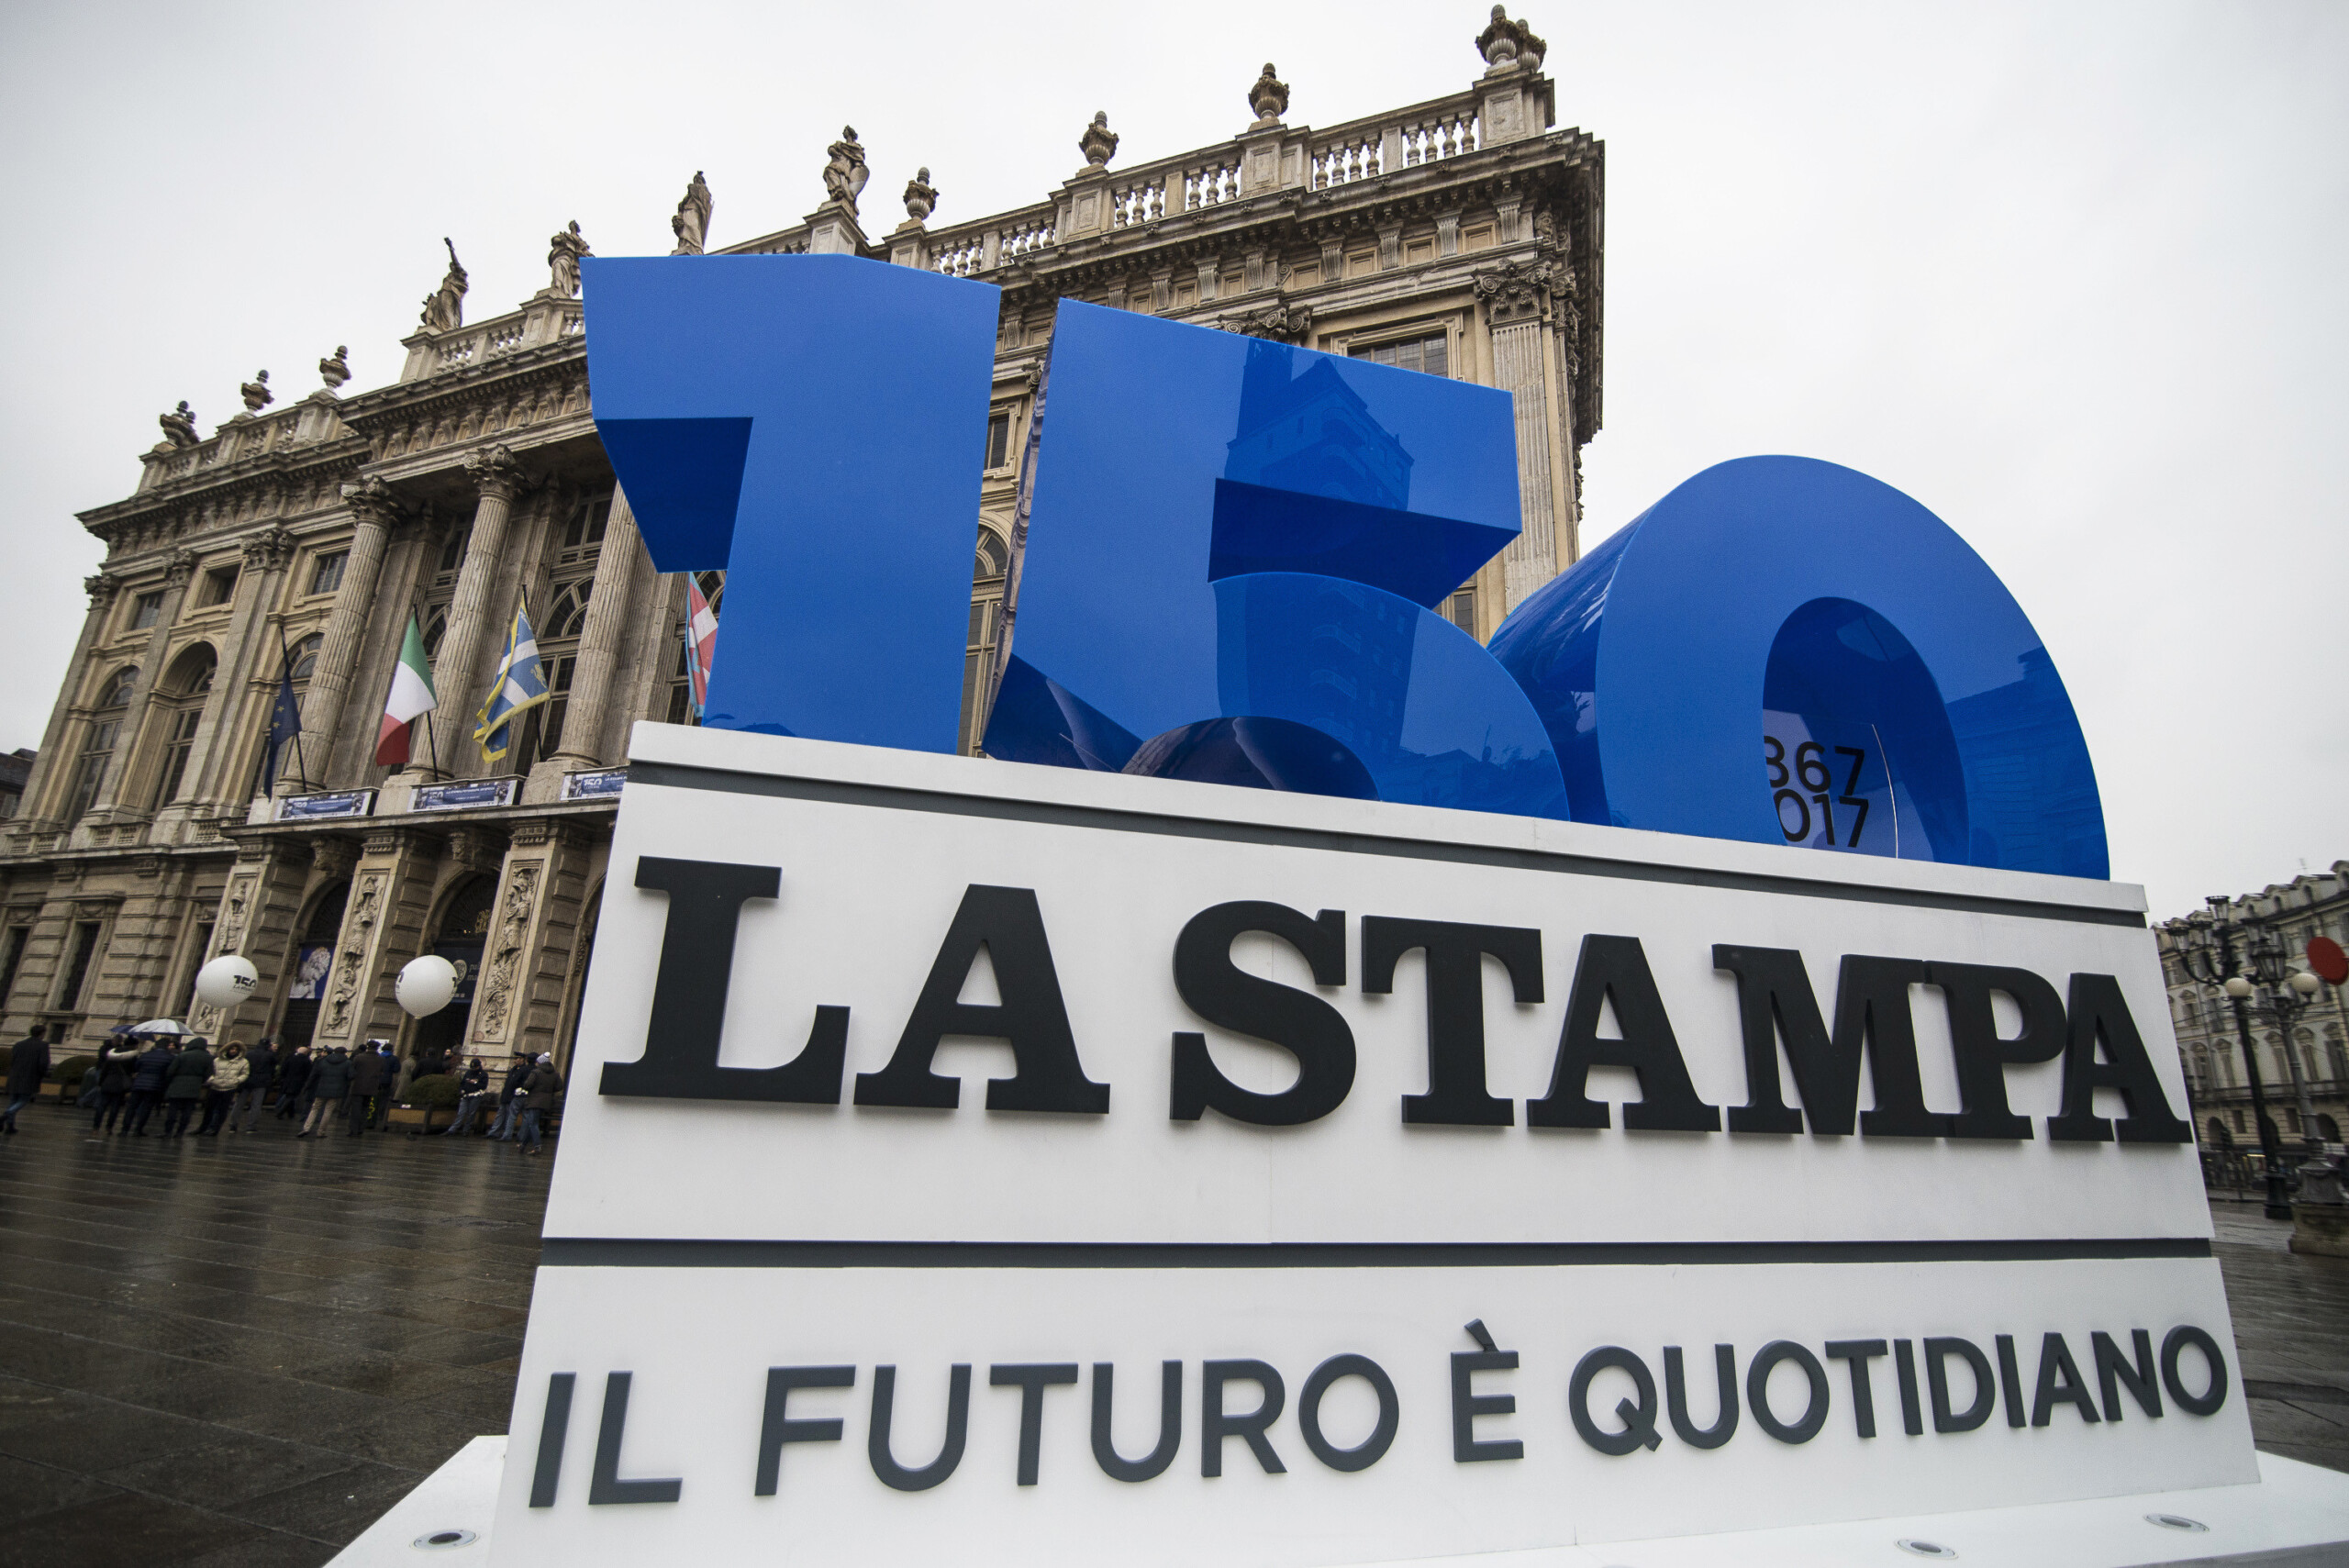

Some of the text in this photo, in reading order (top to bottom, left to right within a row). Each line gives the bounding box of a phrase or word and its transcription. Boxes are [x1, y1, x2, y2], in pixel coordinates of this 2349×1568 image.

[580, 253, 2110, 879] 150
[233, 974, 257, 987] 150
[602, 857, 2194, 1144] LA STAMPA
[529, 1318, 2228, 1507] IL FUTURO È QUOTIDIANO
